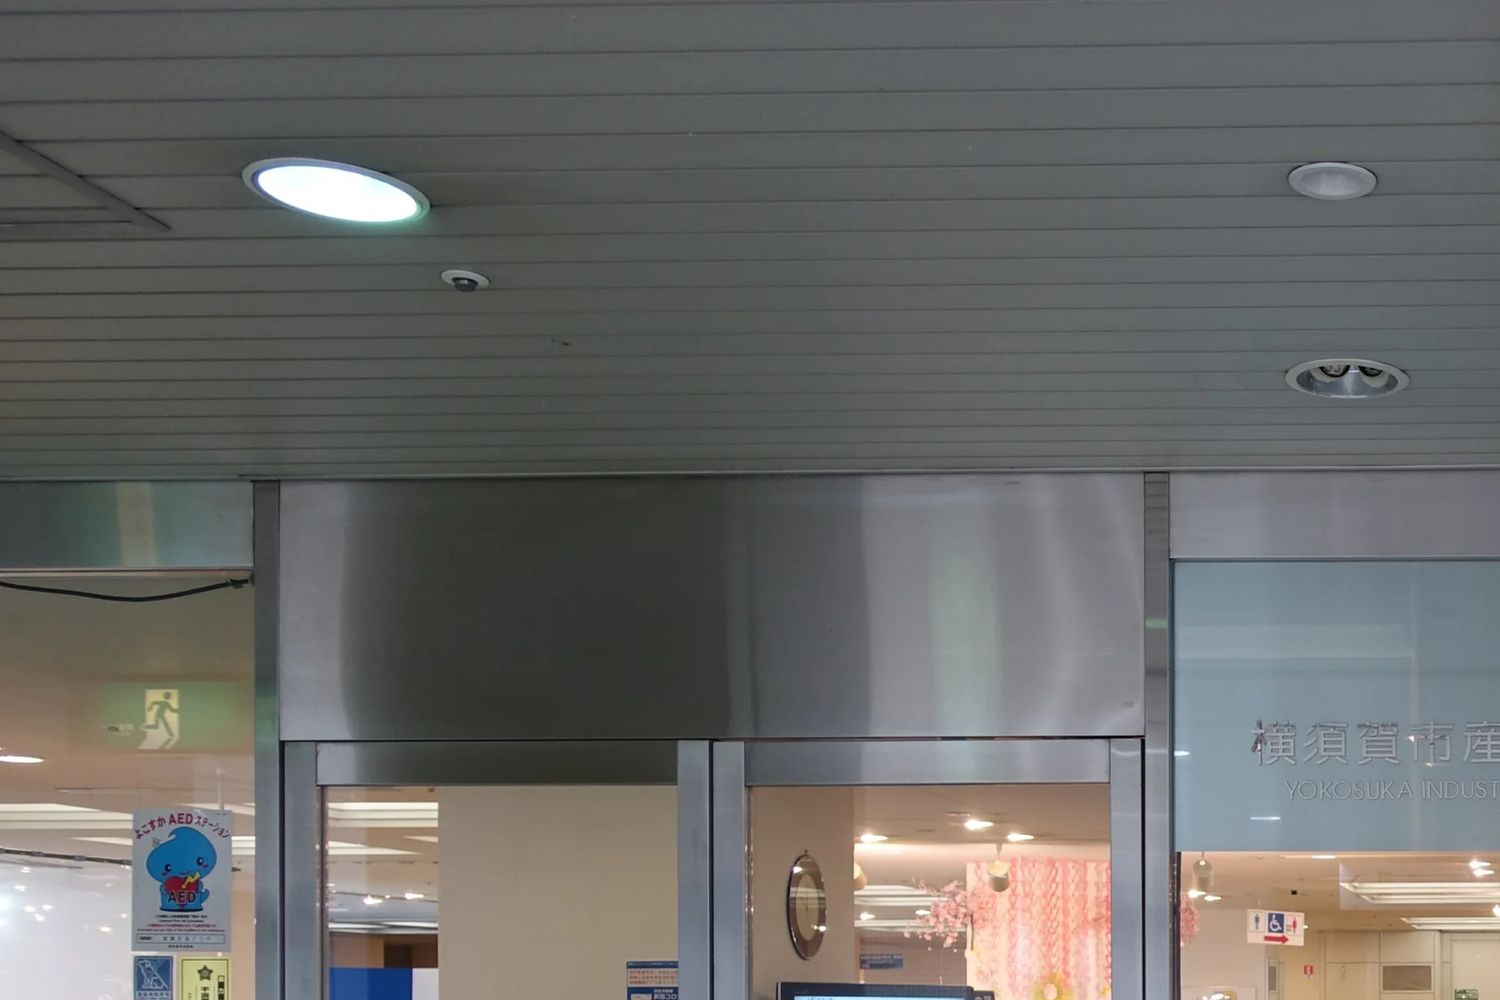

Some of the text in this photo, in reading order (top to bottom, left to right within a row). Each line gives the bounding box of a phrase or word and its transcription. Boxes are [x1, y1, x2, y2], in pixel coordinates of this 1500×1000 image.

[1285, 778, 1414, 801] YOKOSUKA
[135, 813, 230, 840] よこすか AED ステーション
[168, 891, 196, 903] AED
